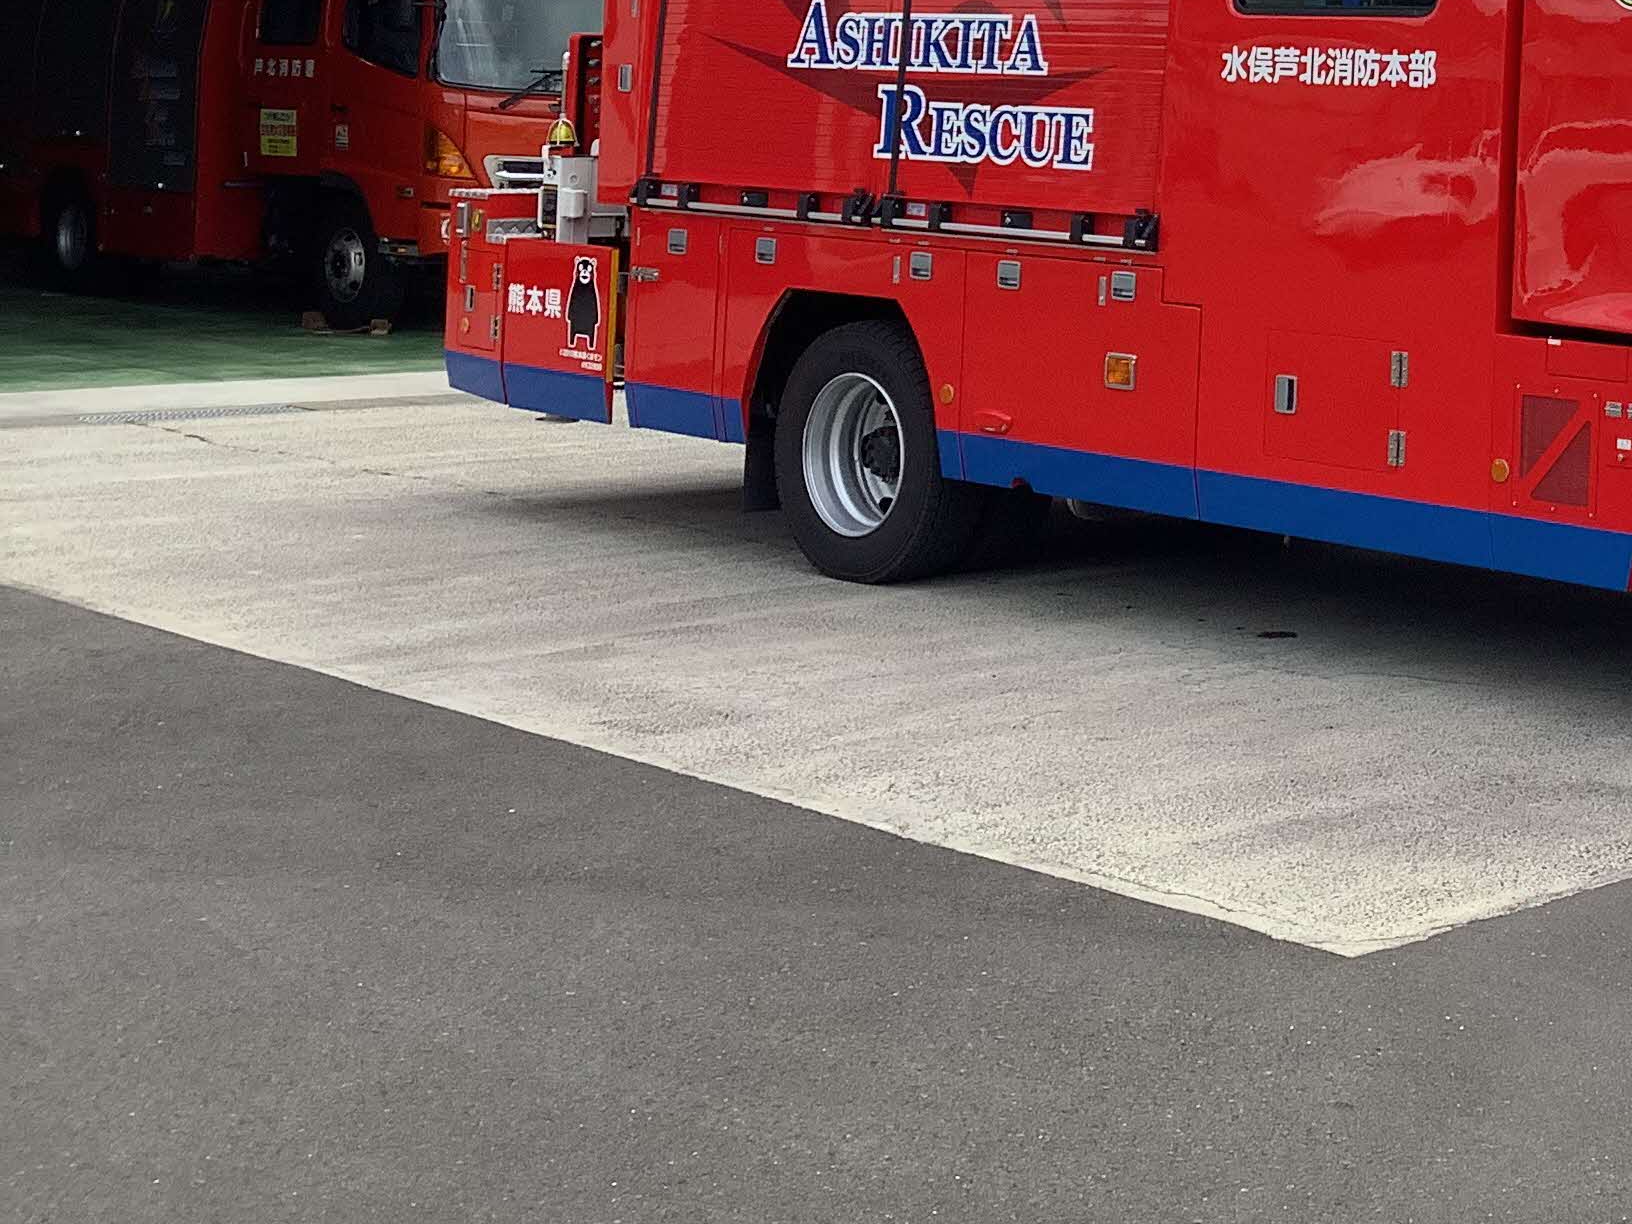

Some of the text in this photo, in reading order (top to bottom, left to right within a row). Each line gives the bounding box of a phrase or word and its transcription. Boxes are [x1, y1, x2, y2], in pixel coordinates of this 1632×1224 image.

[1220, 45, 1437, 88] 水俣芦北消防本部
[507, 283, 561, 318] 熊本県
